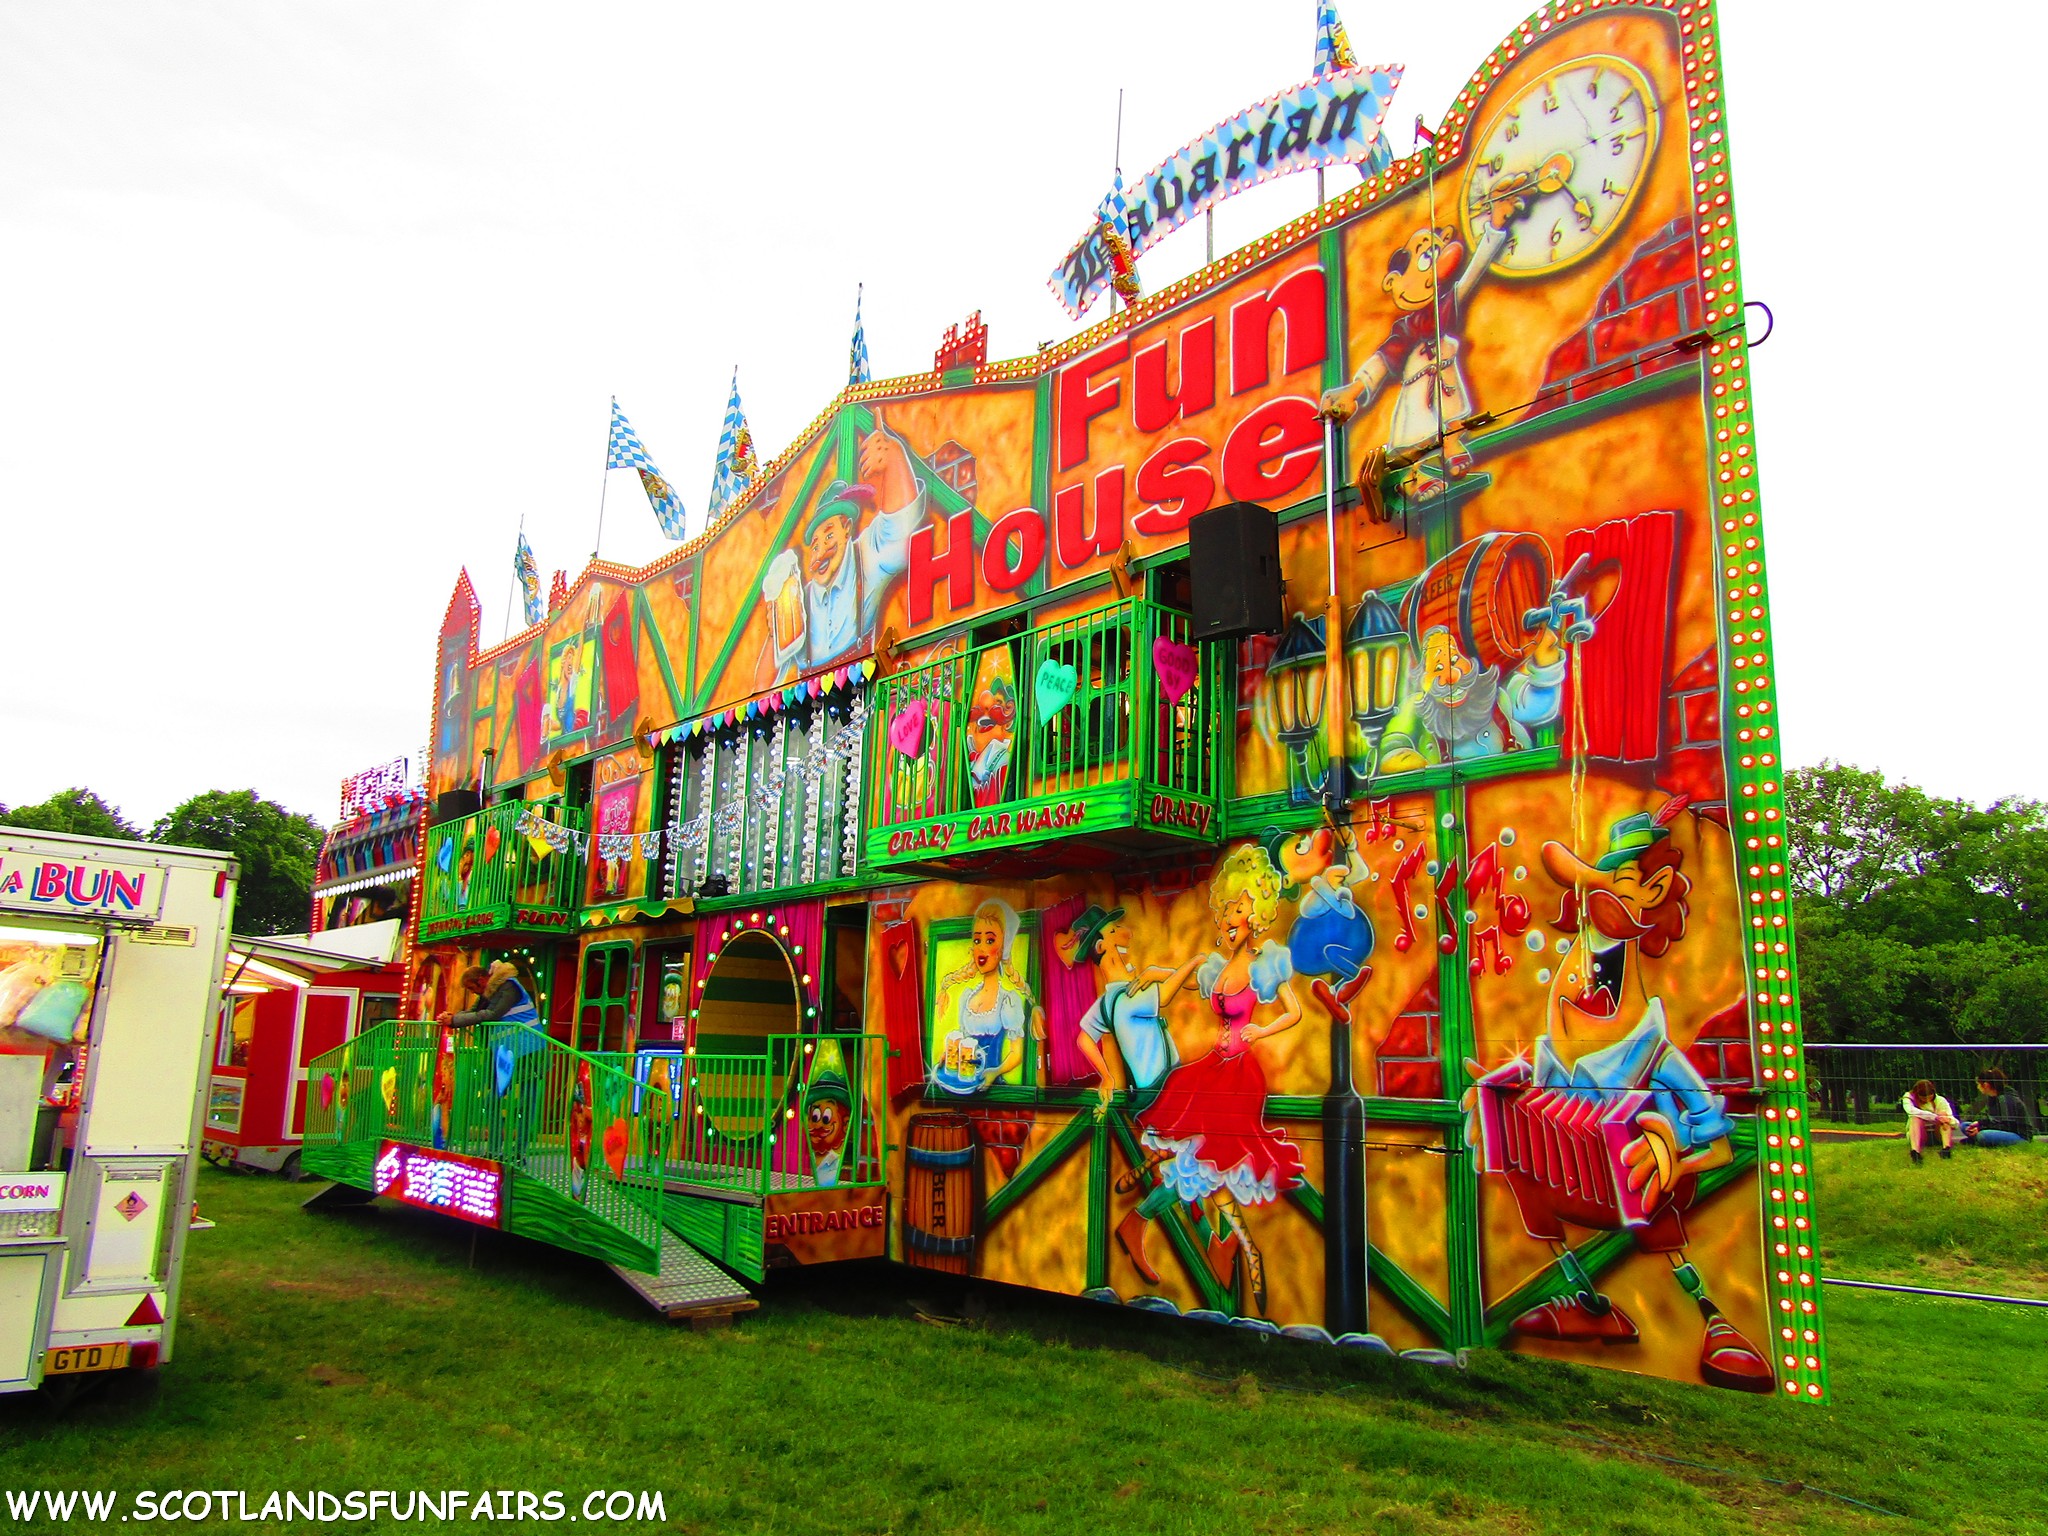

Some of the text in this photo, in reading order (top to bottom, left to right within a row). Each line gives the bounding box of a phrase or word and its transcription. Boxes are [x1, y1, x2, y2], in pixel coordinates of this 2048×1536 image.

[1609, 105, 1623, 123] 2
[1610, 135, 1625, 156] 3
[1602, 178, 1614, 199] 4
[1549, 218, 1562, 246] 6
[1159, 648, 1190, 675] GOOD
[1040, 671, 1073, 695] PEACE
[897, 711, 920, 743] LOVE
[1150, 793, 1212, 836] CRAZY
[887, 801, 1086, 857] CRAZY CAR WASH
[0, 862, 146, 910] A BUN
[516, 909, 568, 927] FUN
[0, 1184, 49, 1200] CORN
[932, 1171, 946, 1229] BEER
[766, 1205, 883, 1239] ENTRANCE
[54, 1347, 101, 1371] GTD
